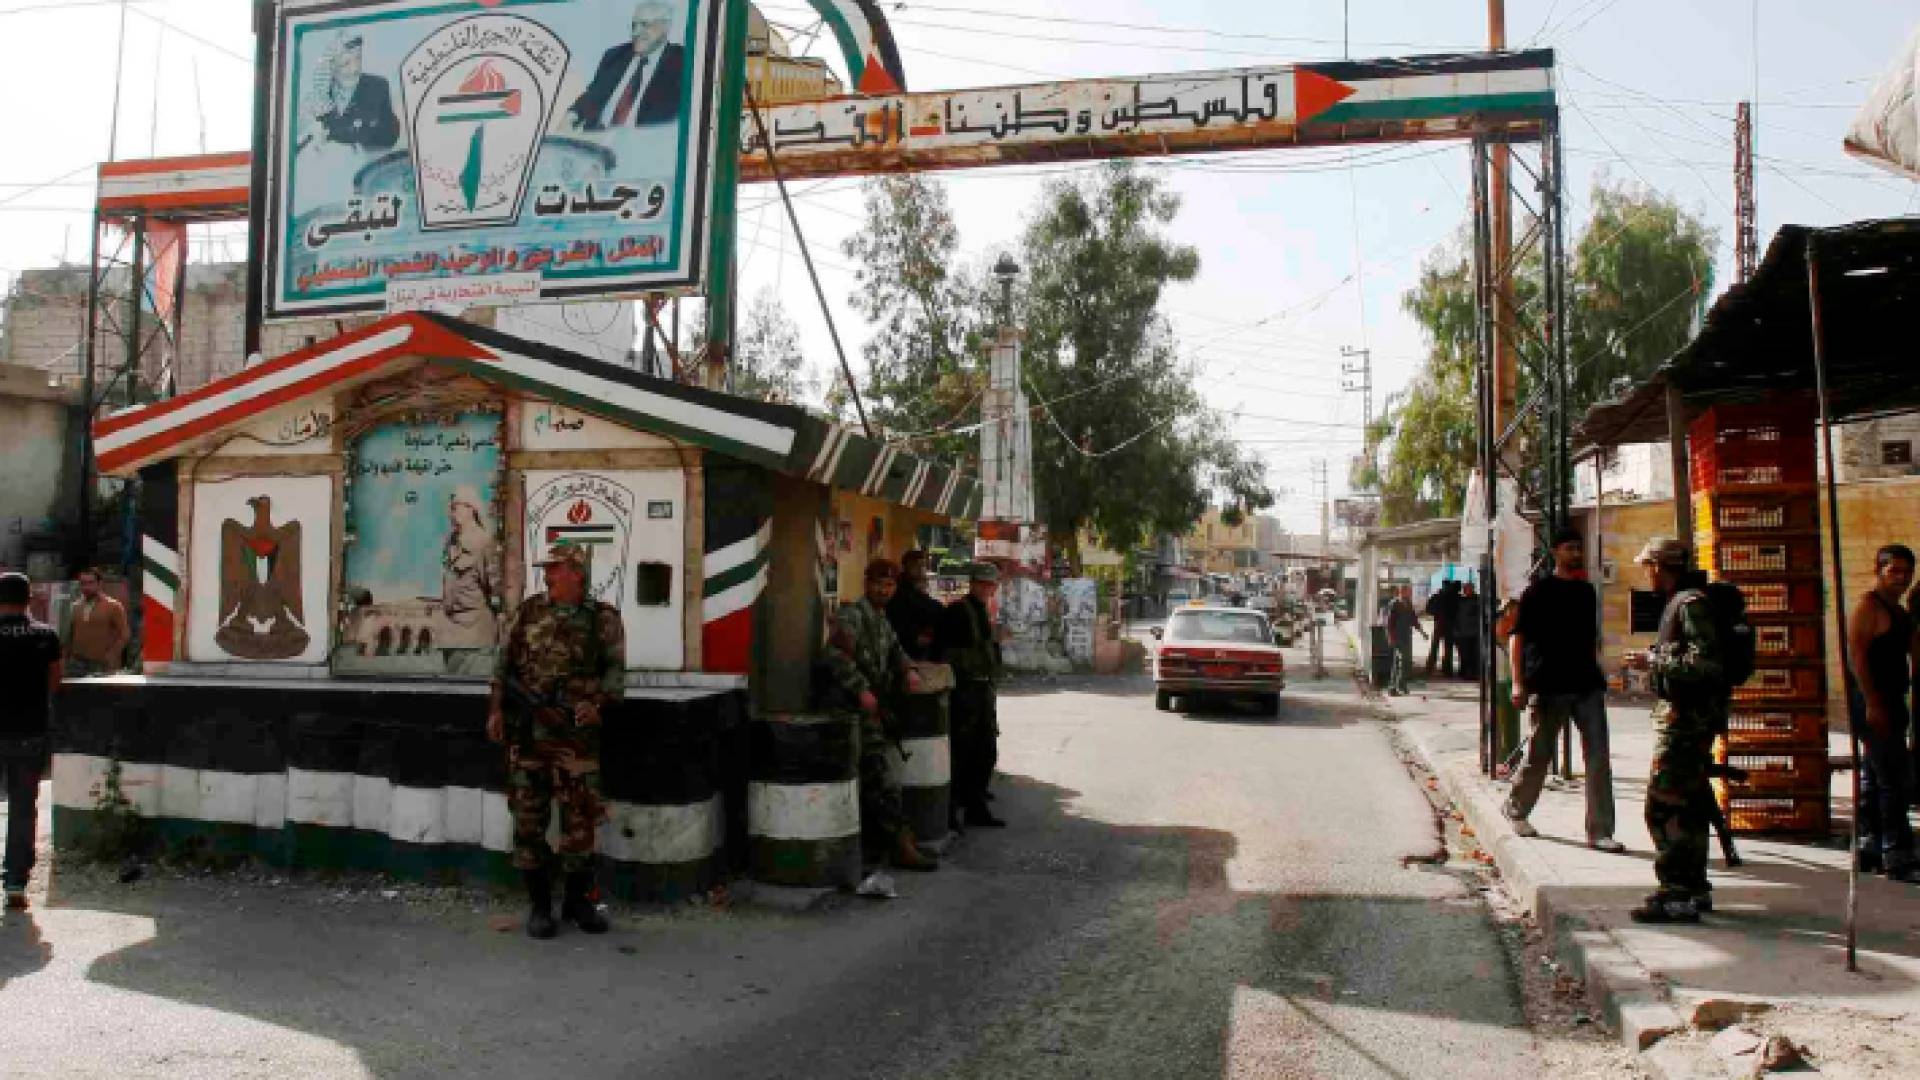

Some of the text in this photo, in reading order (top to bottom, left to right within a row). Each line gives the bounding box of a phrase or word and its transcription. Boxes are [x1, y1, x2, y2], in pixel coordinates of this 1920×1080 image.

[944, 91, 1092, 137] وطننا
[1101, 73, 1279, 134] فلسطين
[306, 194, 402, 248] لتبقى
[534, 182, 666, 219] وجدت
